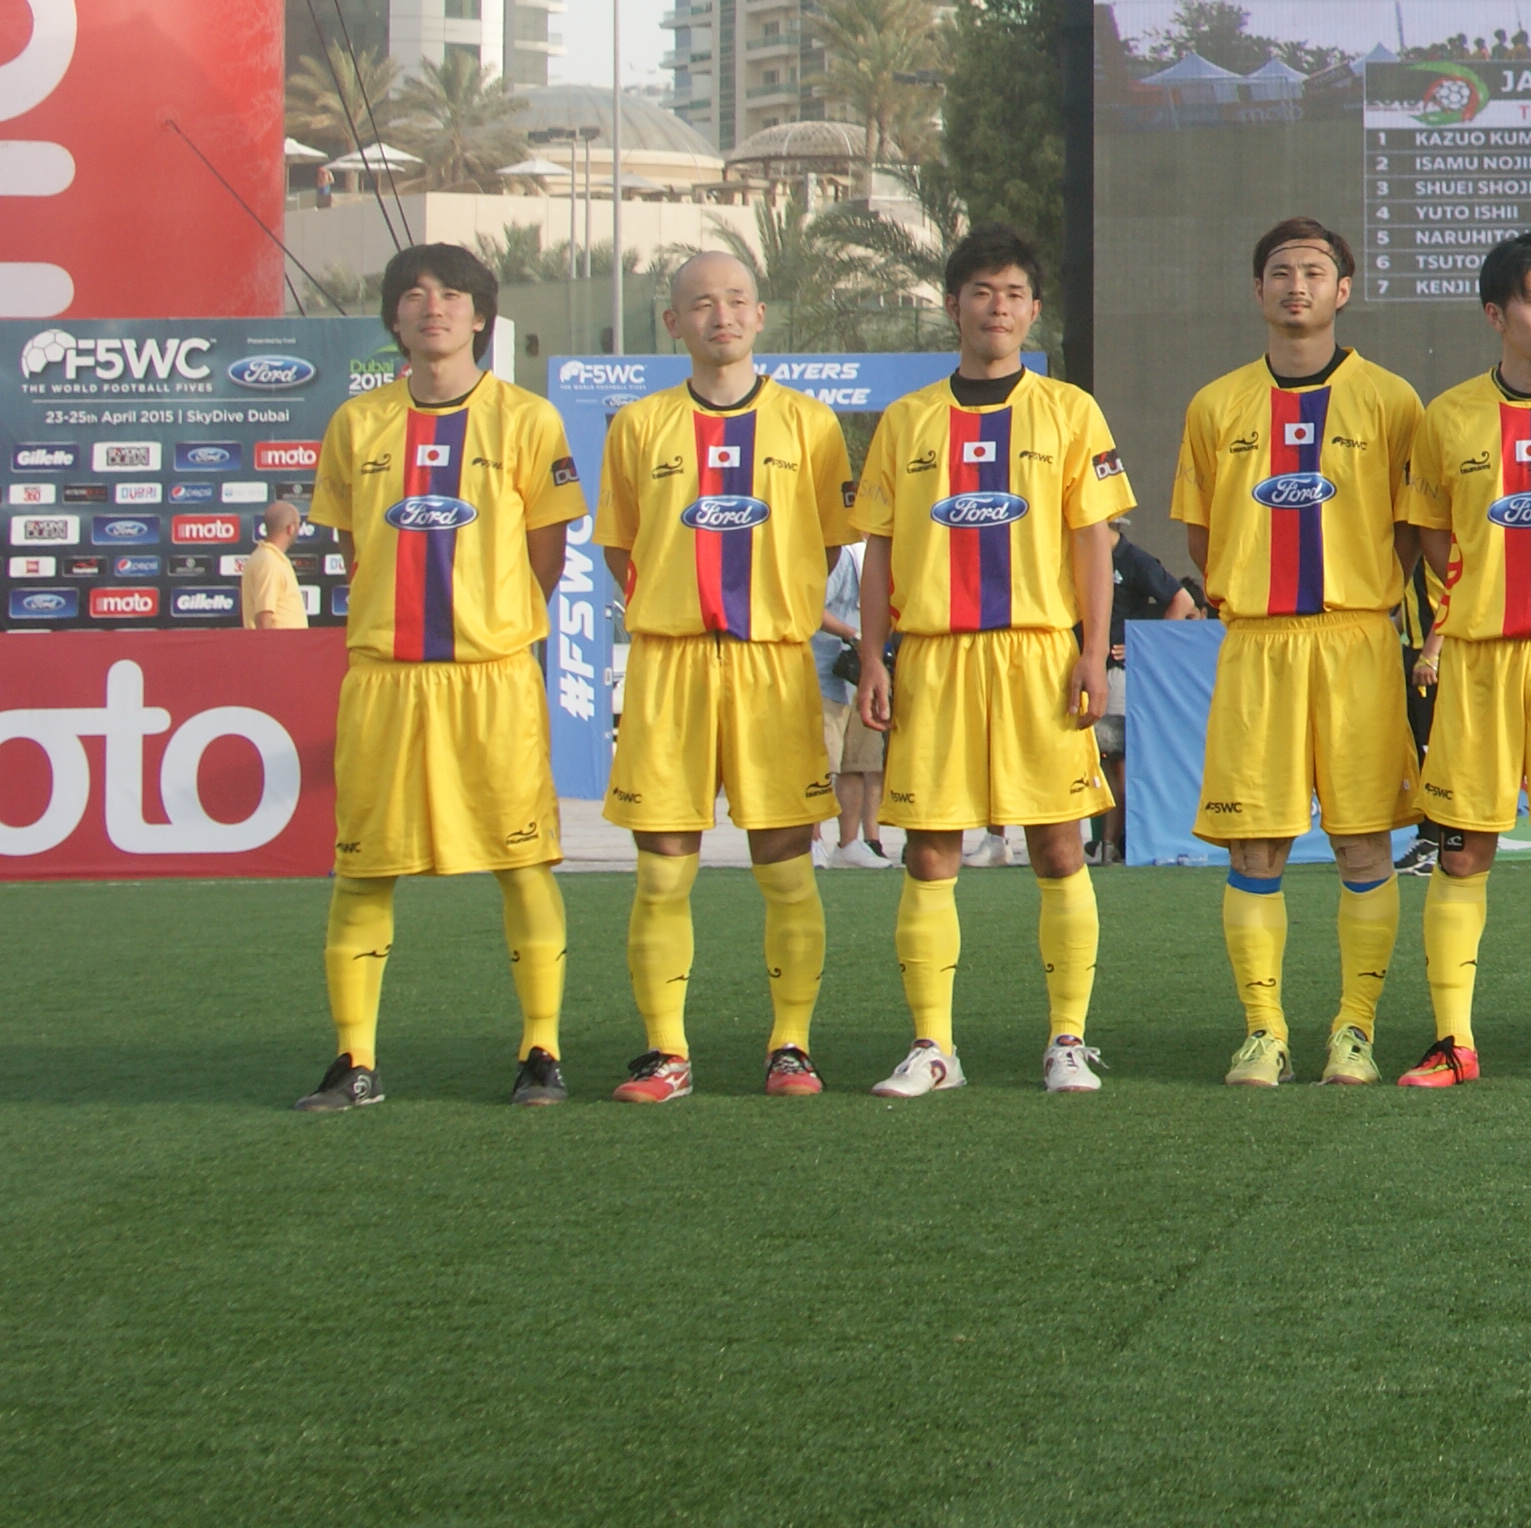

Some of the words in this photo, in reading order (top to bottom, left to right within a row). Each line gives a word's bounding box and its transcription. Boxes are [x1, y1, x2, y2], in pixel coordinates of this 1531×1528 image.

[1378, 132, 1386, 145] 1
[1415, 131, 1486, 146] KAZUO
[1375, 157, 1388, 170] 2
[1415, 156, 1478, 170] ISAMU
[1376, 181, 1389, 196] 3
[1415, 181, 1473, 195] SHUEI
[1375, 206, 1389, 220] 4
[1415, 206, 1469, 220] YUTO
[1475, 205, 1518, 219] ISHII
[1376, 231, 1389, 245] 5
[1416, 230, 1519, 244] NARUHITO
[1376, 255, 1390, 269] 6
[1416, 255, 1484, 269] TSUTO
[1377, 280, 1389, 293] 7
[1416, 280, 1470, 294] KENJI
[65, 337, 211, 380] F5WC
[350, 358, 394, 373] Dubai
[244, 359, 296, 383] Ford
[579, 363, 645, 384] F5WC
[21, 383, 46, 394] THE
[51, 383, 98, 394] WORLD
[103, 382, 171, 393] FOOTBALL
[176, 382, 214, 393] FIVES
[349, 373, 396, 391] 2015
[45, 410, 98, 424] 23-25th
[101, 410, 137, 426] April
[140, 410, 174, 423] 2015
[187, 409, 244, 425] SkyDive
[248, 409, 290, 423] Dubai
[16, 448, 74, 466] Gillette
[267, 445, 317, 465] moto
[1271, 477, 1324, 503] Ford
[1411, 476, 1440, 499] KIN
[401, 501, 457, 526] Ford
[695, 500, 753, 525] Ford
[949, 496, 1009, 522] Ford
[184, 519, 235, 539] moto
[102, 592, 153, 612] moto
[176, 592, 234, 611] Gillette
